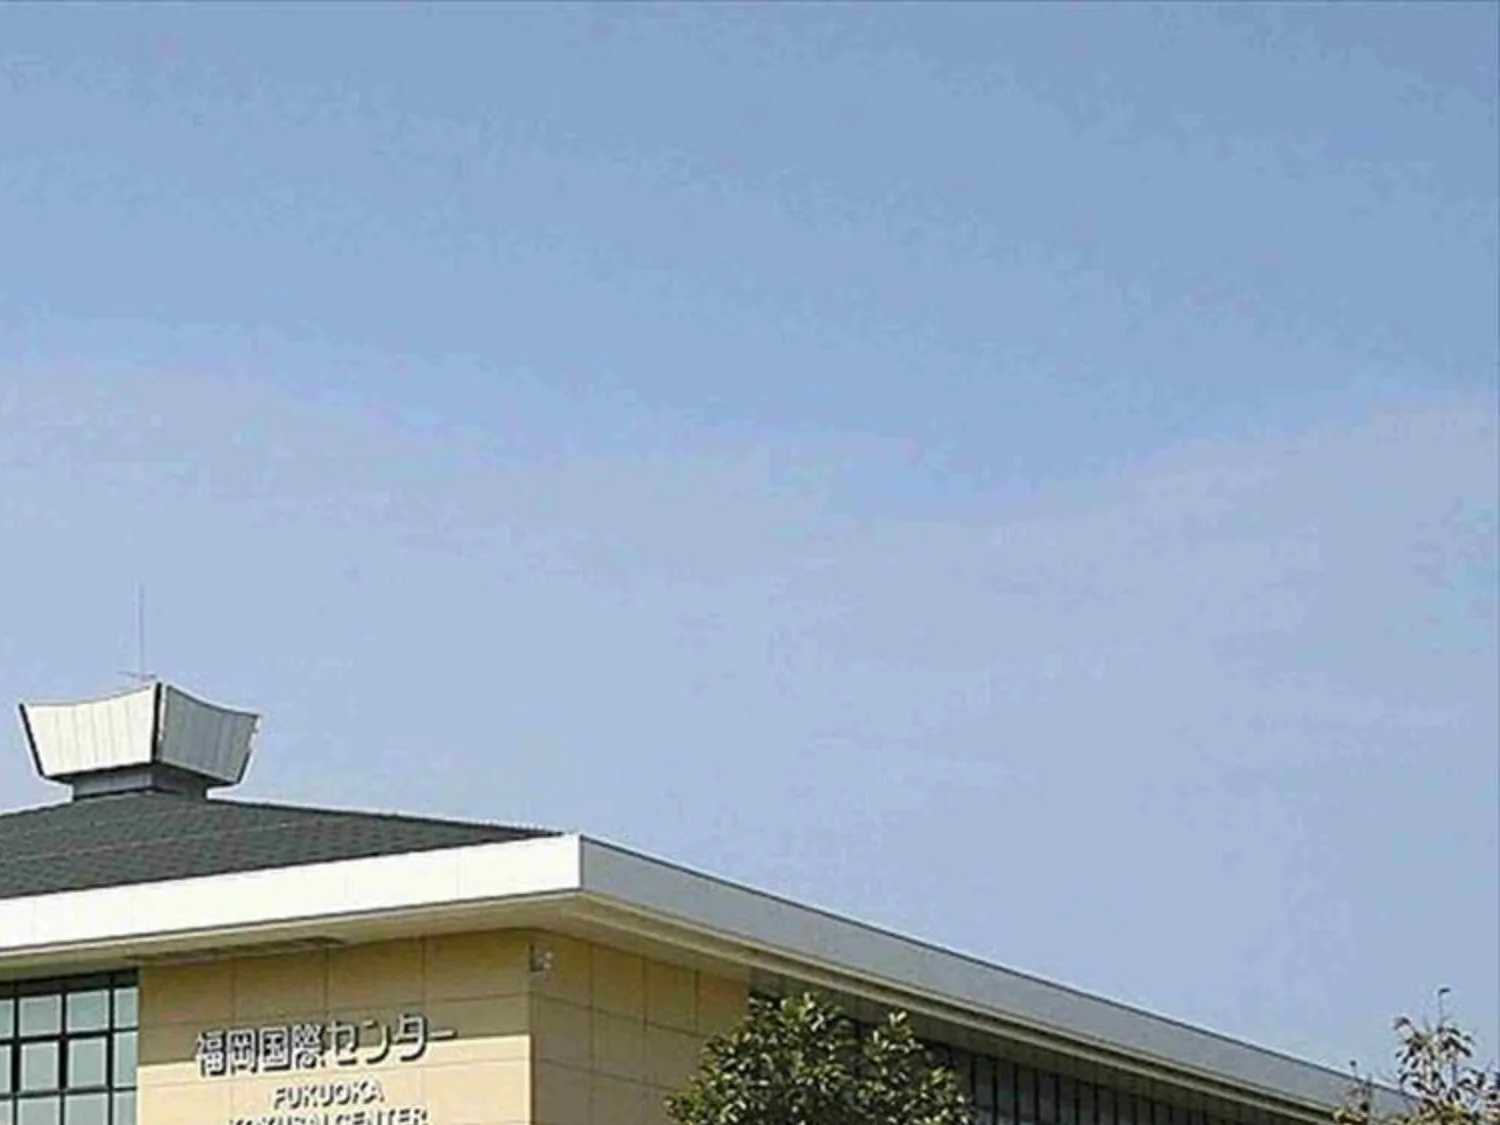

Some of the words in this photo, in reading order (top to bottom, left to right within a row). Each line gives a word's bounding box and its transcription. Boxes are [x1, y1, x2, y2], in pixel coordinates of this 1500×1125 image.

[196, 1013, 457, 1077] 福岡国際センター
[273, 1078, 385, 1110] FUKUOKA
